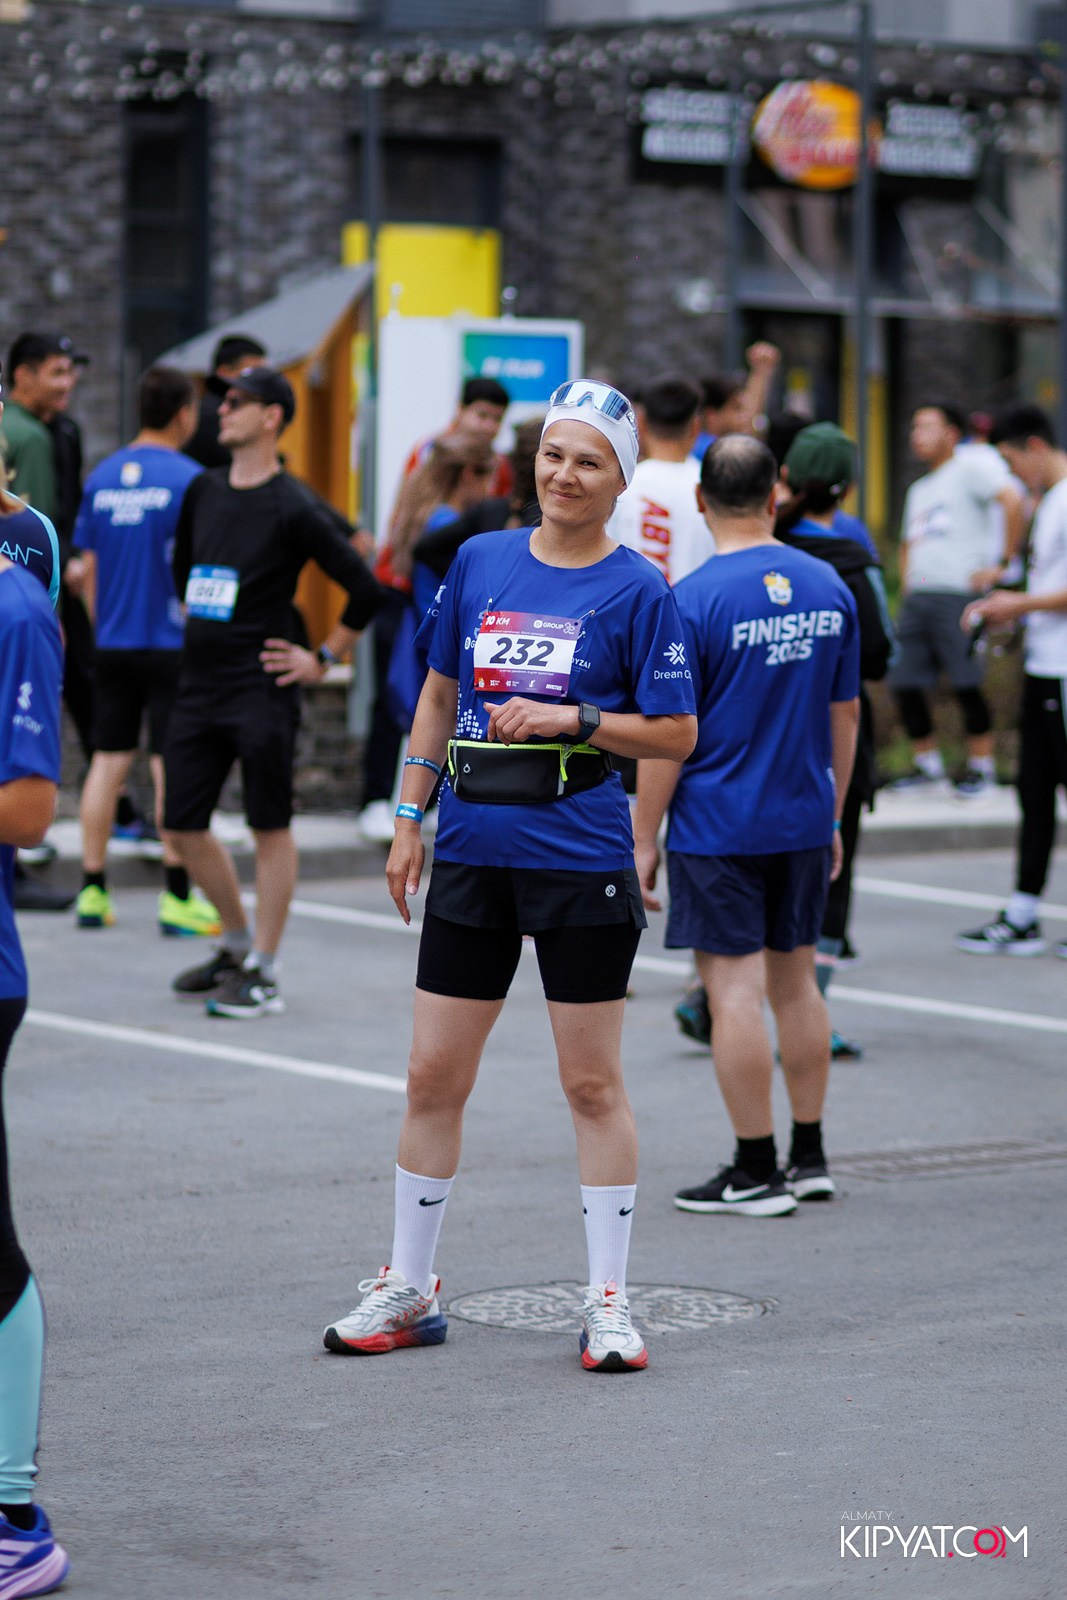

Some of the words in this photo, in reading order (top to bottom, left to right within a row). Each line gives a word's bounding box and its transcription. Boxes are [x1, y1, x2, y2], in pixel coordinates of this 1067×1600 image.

[485, 615, 496, 625] 10
[496, 617, 510, 625] KM
[732, 610, 843, 650] FINISHER
[489, 636, 554, 667] 232
[765, 638, 813, 666] 2025
